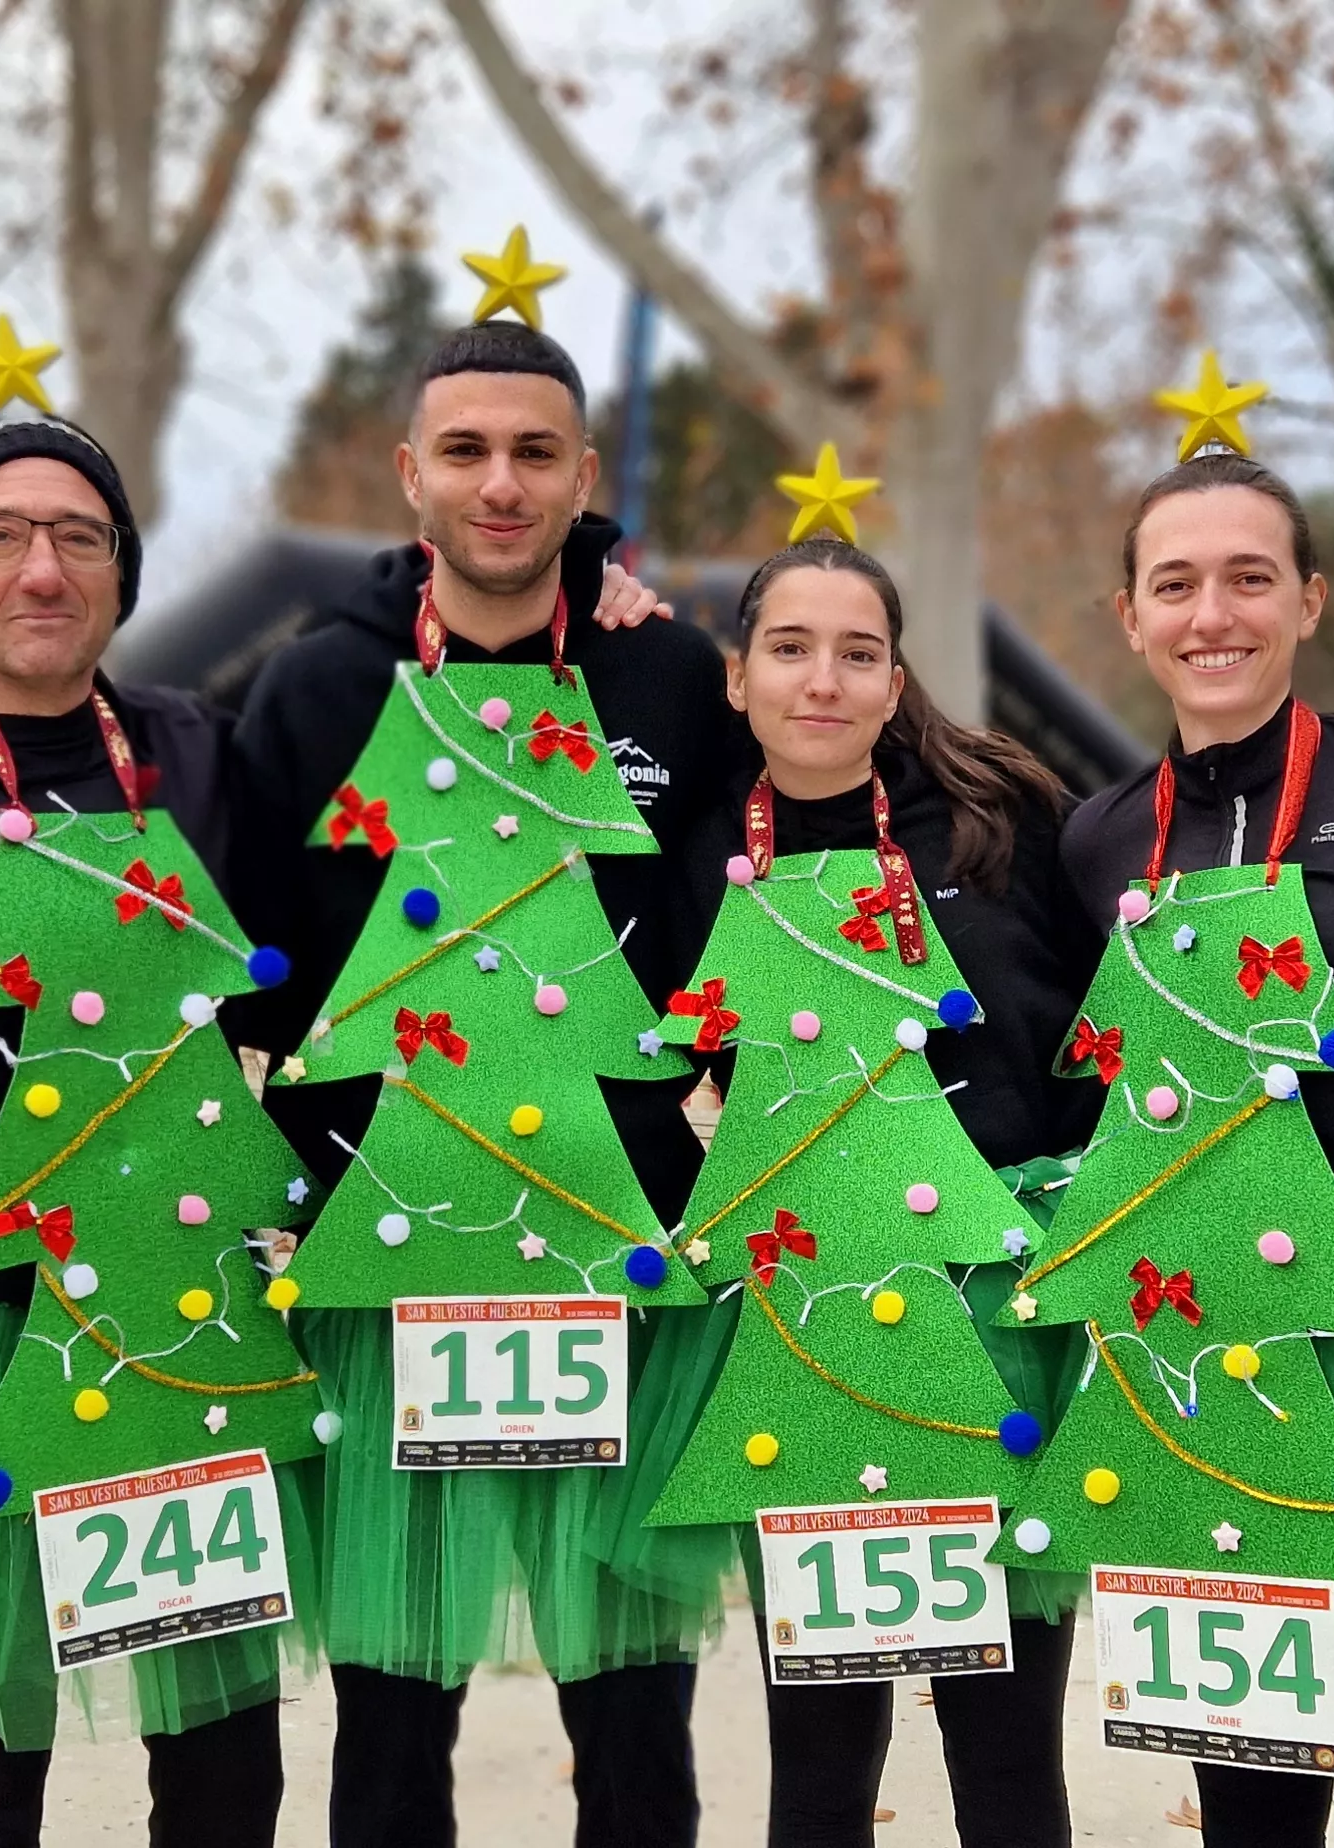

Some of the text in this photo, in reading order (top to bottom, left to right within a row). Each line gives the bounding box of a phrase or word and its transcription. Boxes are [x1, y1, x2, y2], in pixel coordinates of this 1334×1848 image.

[618, 763, 670, 786] gonia
[405, 1303, 561, 1320] SAN SILVESTRE HUESCA 2024
[431, 1330, 608, 1416] 115
[500, 1425, 534, 1434] LORIEN
[48, 1495, 71, 1512] SAN
[74, 1481, 133, 1508] SILVESTRE
[134, 1473, 178, 1495] HUESCA
[180, 1466, 207, 1486] 2024
[770, 1515, 791, 1531] SAN
[794, 1512, 852, 1531] SILVESTRE
[854, 1510, 898, 1527] HUESCA
[900, 1508, 930, 1524] 2024
[76, 1486, 268, 1608] 244
[797, 1533, 987, 1629] 155
[1105, 1574, 1127, 1591] SAN
[1130, 1575, 1188, 1595] SILVESTRE
[1190, 1579, 1234, 1599] HUESCA
[1236, 1583, 1265, 1601] 2024
[158, 1595, 193, 1610] OSCAR
[874, 1633, 915, 1645] SESCUN
[1134, 1606, 1325, 1714] 154
[1207, 1715, 1242, 1728] IZARBE
